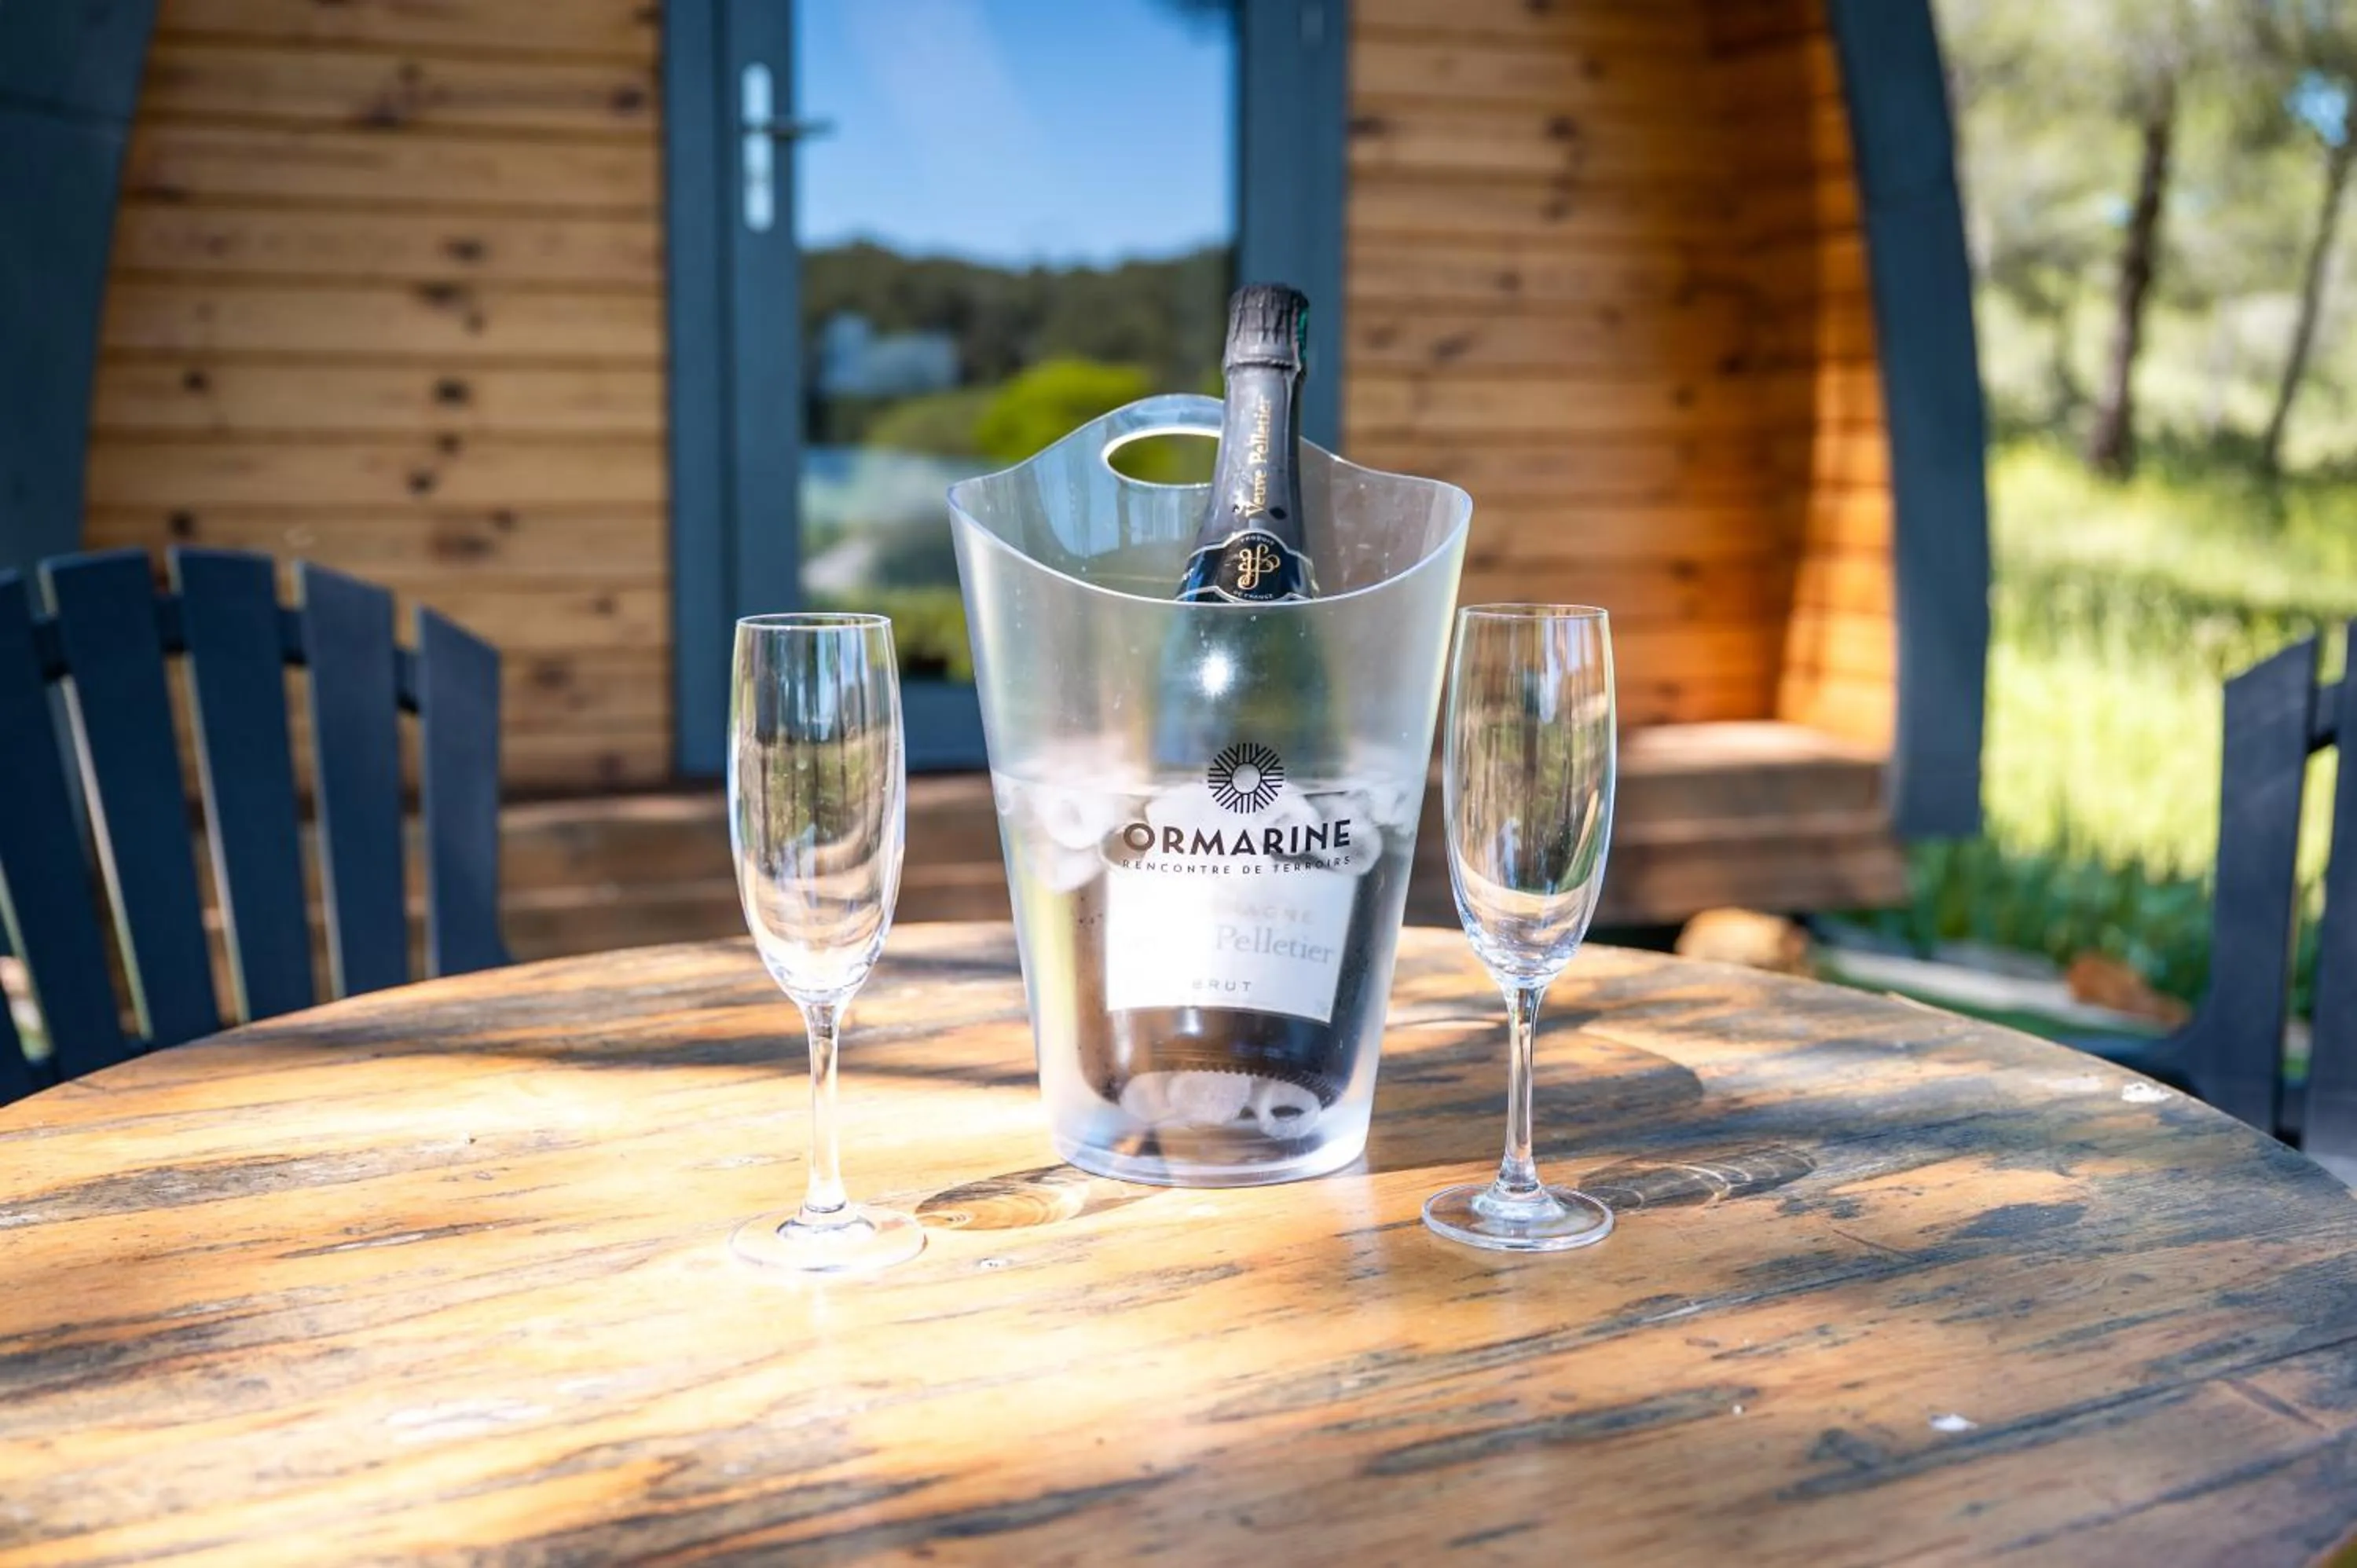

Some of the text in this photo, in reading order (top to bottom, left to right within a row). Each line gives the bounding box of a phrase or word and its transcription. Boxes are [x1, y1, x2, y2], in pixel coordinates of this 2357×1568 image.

[1248, 395, 1271, 463] Pelletier
[1245, 469, 1266, 518] Veuve
[1124, 819, 1351, 855] ORMARINE
[1123, 855, 1351, 874] RENCONTRE DE TERROIRS
[1216, 924, 1334, 964] Pelletier
[1192, 978, 1252, 992] BRUT
